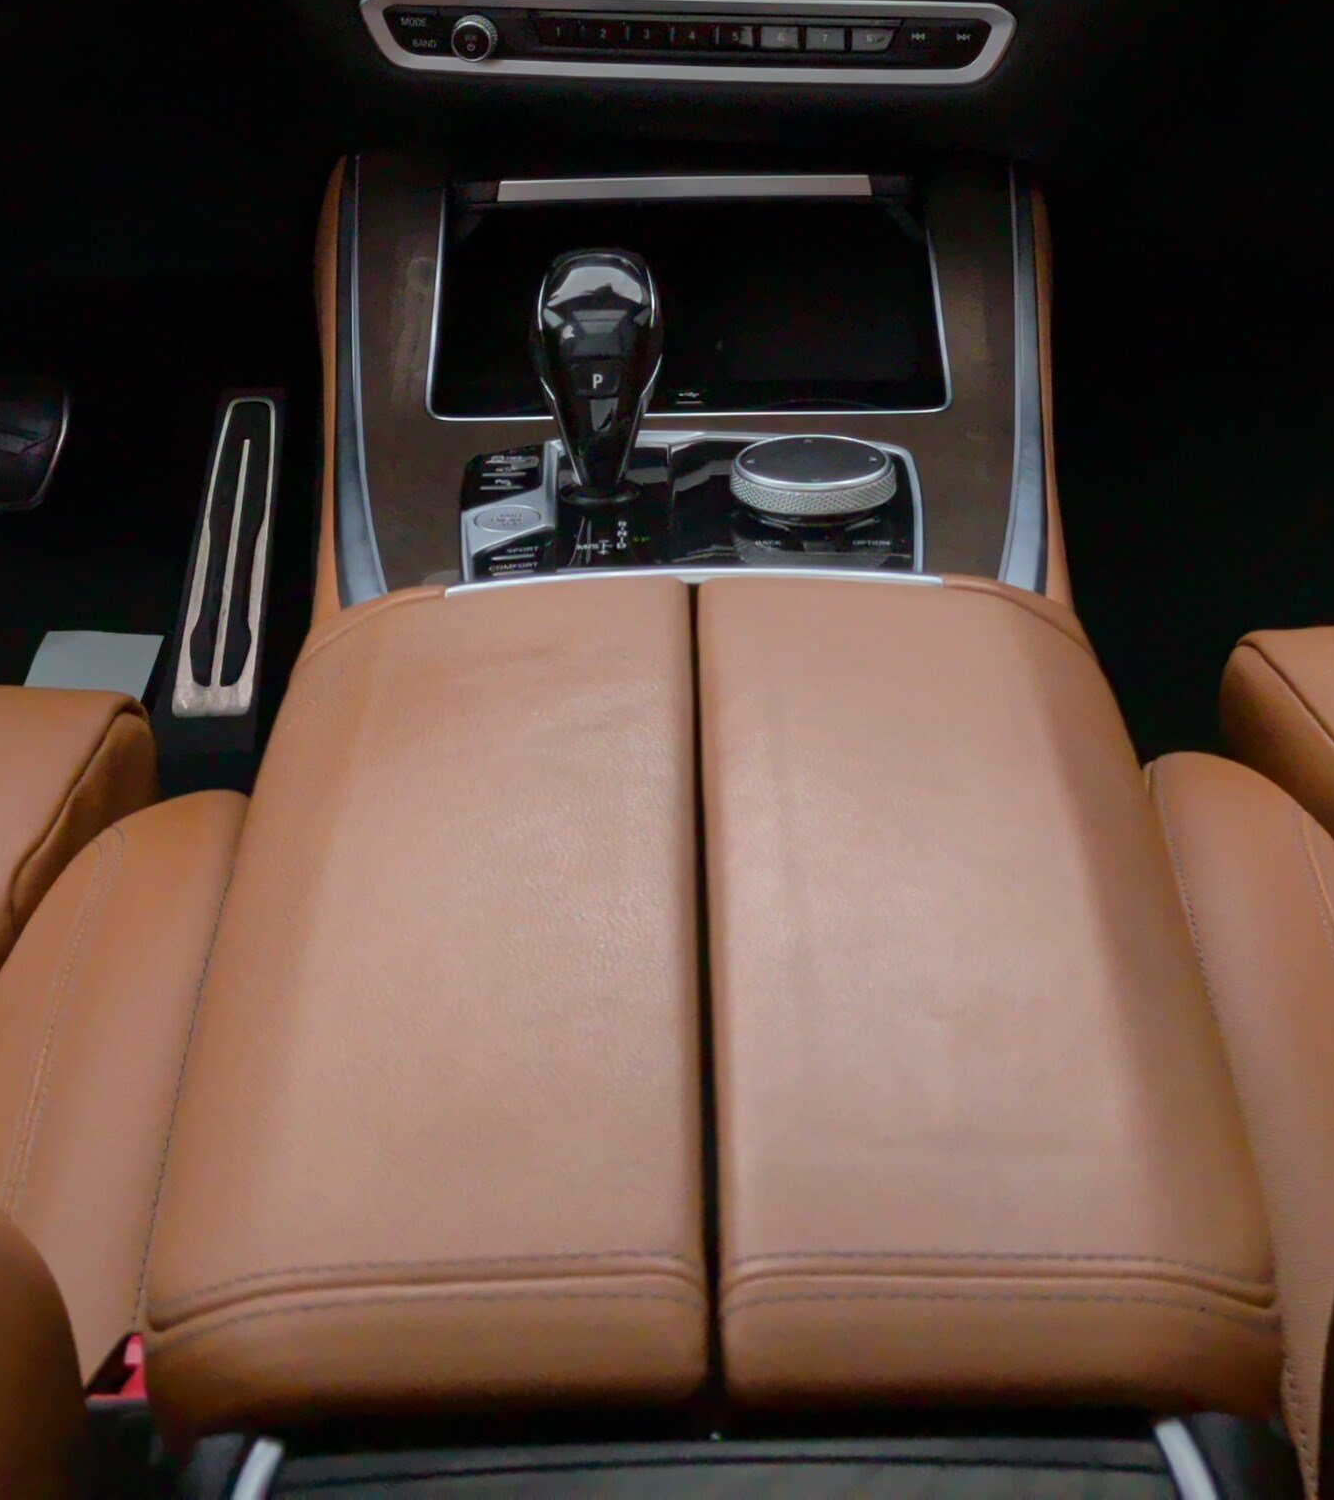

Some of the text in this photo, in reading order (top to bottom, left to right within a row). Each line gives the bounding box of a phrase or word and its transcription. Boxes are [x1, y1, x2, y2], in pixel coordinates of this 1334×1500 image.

[400, 17, 427, 27] MODE
[592, 373, 603, 390] P
[507, 545, 539, 554] SPORT
[488, 561, 539, 573] COMFORT
